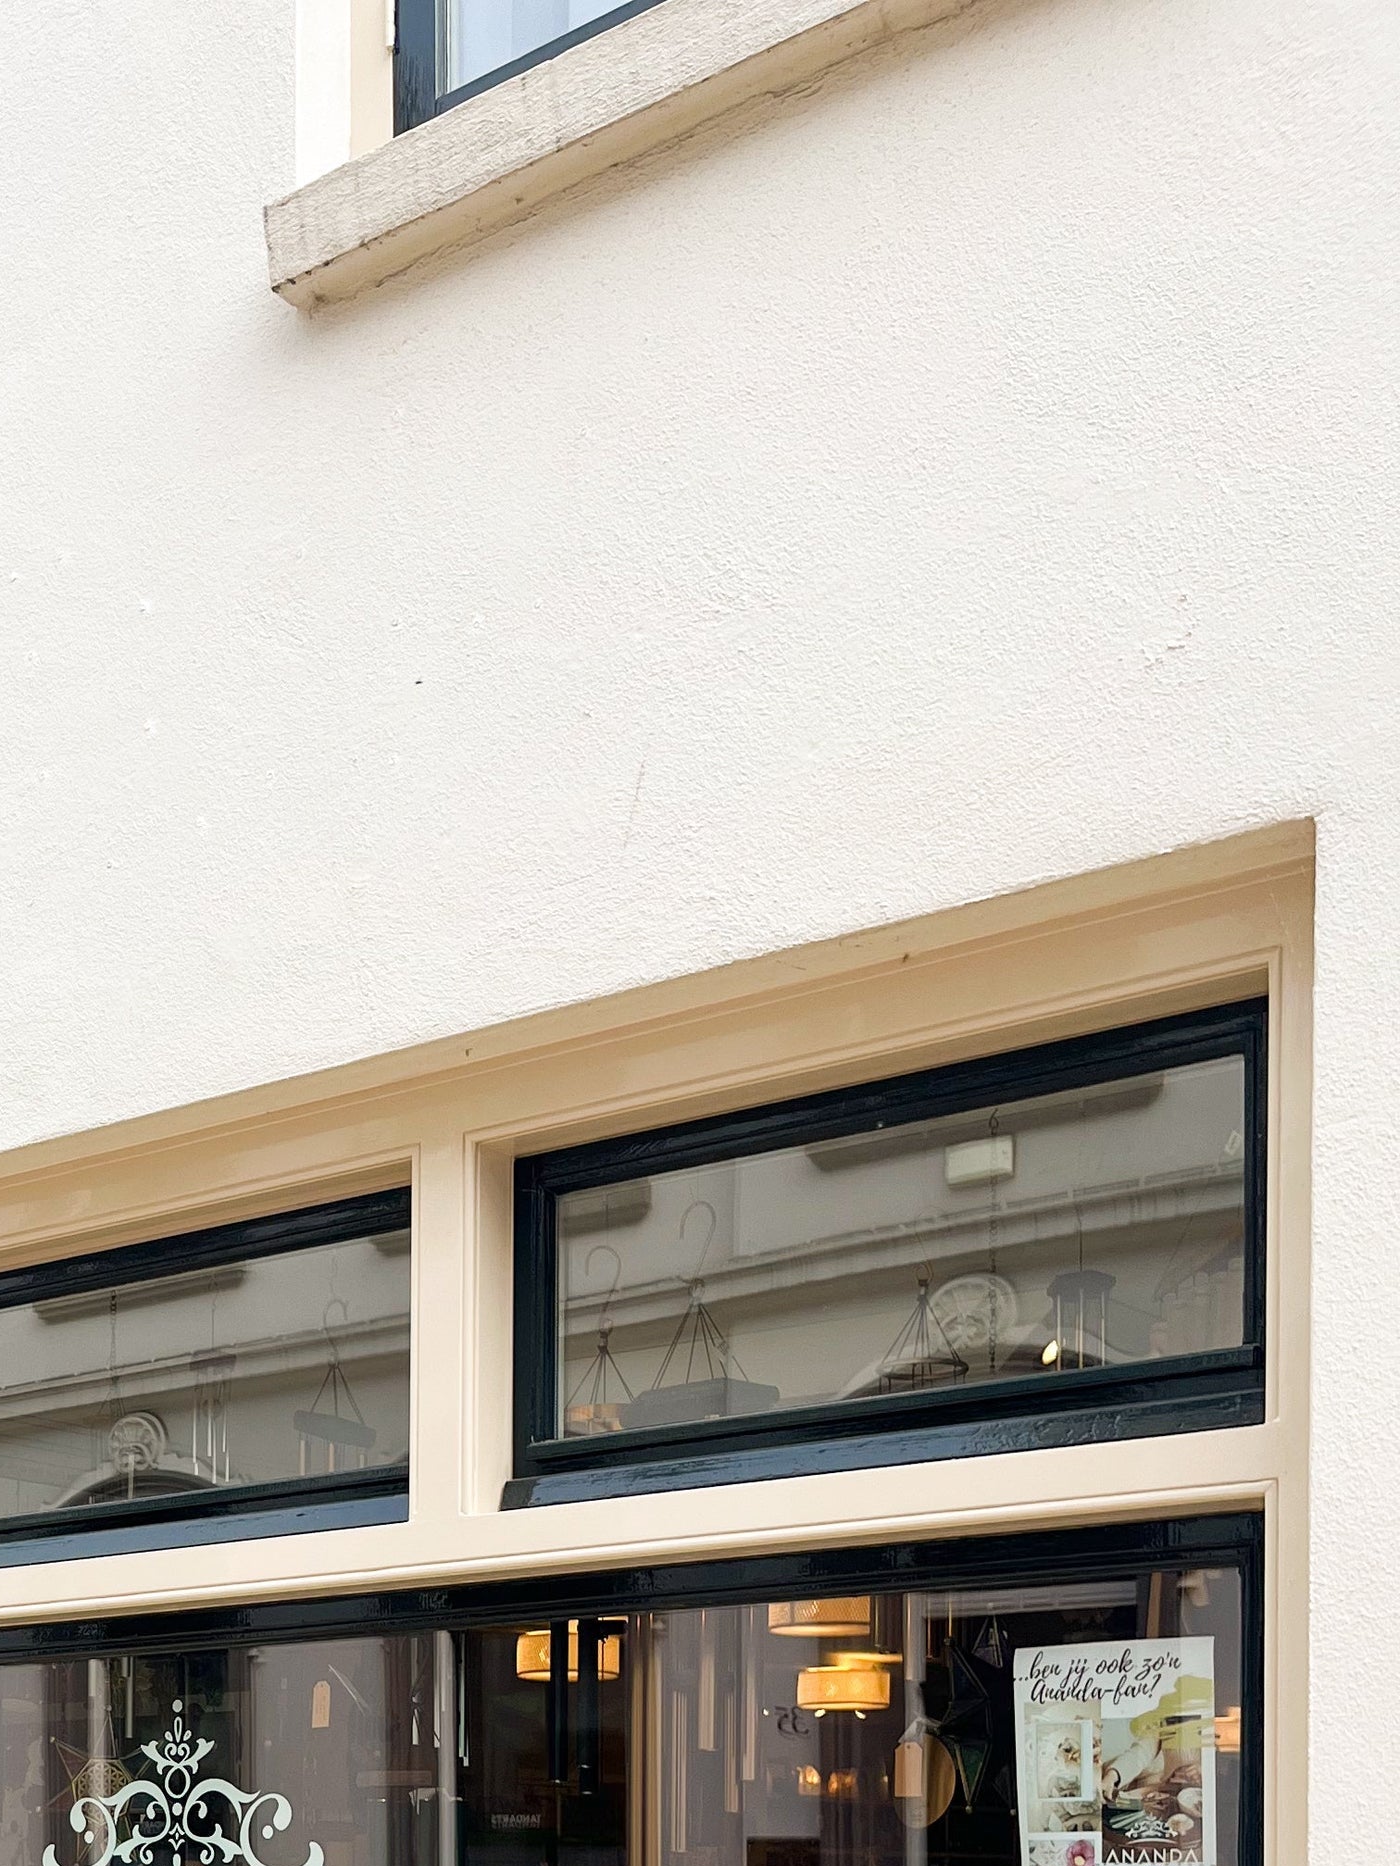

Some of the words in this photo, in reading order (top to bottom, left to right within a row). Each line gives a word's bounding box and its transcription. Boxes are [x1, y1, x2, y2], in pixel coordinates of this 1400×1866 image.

[1060, 1658, 1088, 1688] jij
[1095, 1648, 1135, 1675] ook
[1135, 1652, 1182, 1681] zo'n
[1030, 1673, 1162, 1706] Ananda-fan?
[1105, 1847, 1200, 1865] ANANDA
